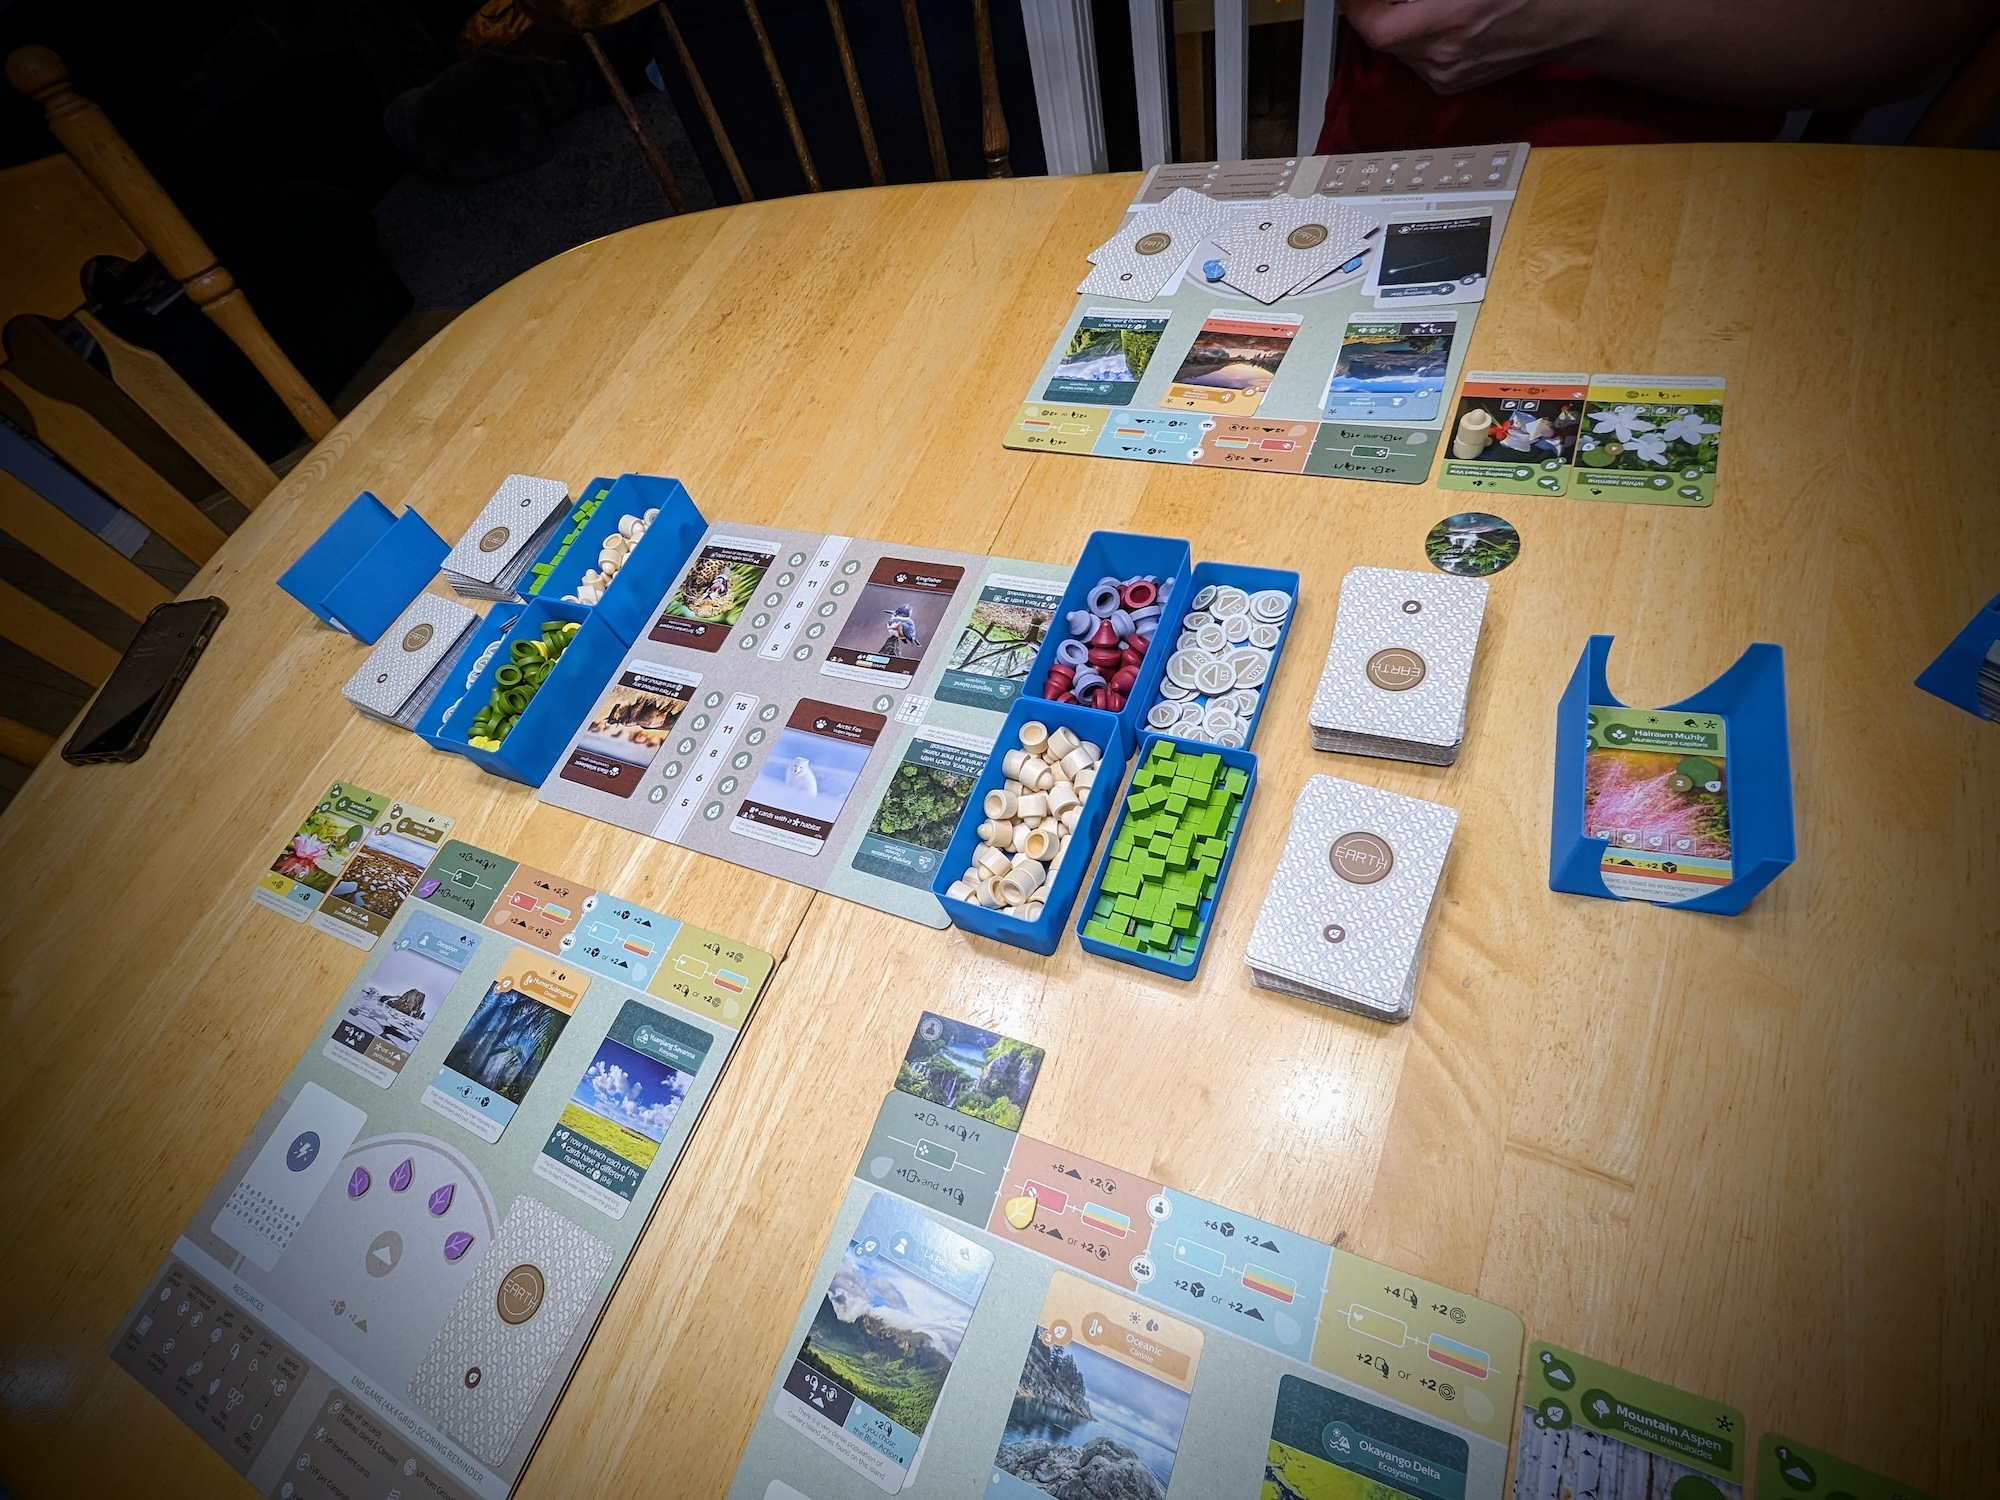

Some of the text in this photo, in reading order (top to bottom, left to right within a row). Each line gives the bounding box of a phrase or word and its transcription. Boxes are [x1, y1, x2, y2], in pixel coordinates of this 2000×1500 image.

[1371, 662, 1420, 677] EARTH
[1634, 729, 1705, 742] Hairawn Muhly
[757, 810, 773, 818] cards
[773, 814, 787, 822] with
[799, 821, 821, 831] habitat
[1335, 846, 1387, 869] EARTH
[533, 977, 575, 1000] Humid Subtropical
[647, 1033, 696, 1059] Yuanjiang Savanna
[912, 1109, 980, 1142] +2 +4 /1
[555, 1129, 640, 1179] 6 /row in which each of the
[559, 1142, 566, 1150] 4
[565, 1144, 582, 1158] cards
[580, 1152, 596, 1166] have
[599, 1162, 626, 1182] different
[563, 1153, 595, 1175] number of
[895, 1166, 954, 1196] +1 and +1
[1050, 1161, 1102, 1187] +5 +2
[1031, 1221, 1094, 1253] +2 or +2
[1202, 1217, 1259, 1246] +6 +2
[923, 1250, 959, 1274] La Palma
[232, 1283, 264, 1311] RESOURCES
[503, 1277, 538, 1310] EARTH
[1172, 1277, 1244, 1313] +2 or +2
[1382, 1284, 1449, 1316] +4 +2
[1124, 1332, 1163, 1356] Oceanic
[1128, 1347, 1154, 1364] Climate
[1354, 1350, 1438, 1391] +2 or +2
[351, 1375, 364, 1390] END
[363, 1385, 383, 1405] GAME
[395, 1411, 417, 1435] GRID)
[415, 1426, 447, 1456] SCORING
[446, 1450, 483, 1484] REMINDER
[796, 1406, 883, 1468] There is a very dense population of
[861, 1421, 896, 1449] if you chose
[873, 1417, 884, 1429] +2
[1614, 1404, 1723, 1454] Mountain Aspen
[786, 1409, 886, 1480] Canary Island pines found on this island.
[852, 1426, 899, 1461] the Blue Action
[1621, 1419, 1714, 1461] Populus tremuloides
[1357, 1439, 1441, 1480] Okavango Delta
[1377, 1461, 1419, 1484] Ecosystem
